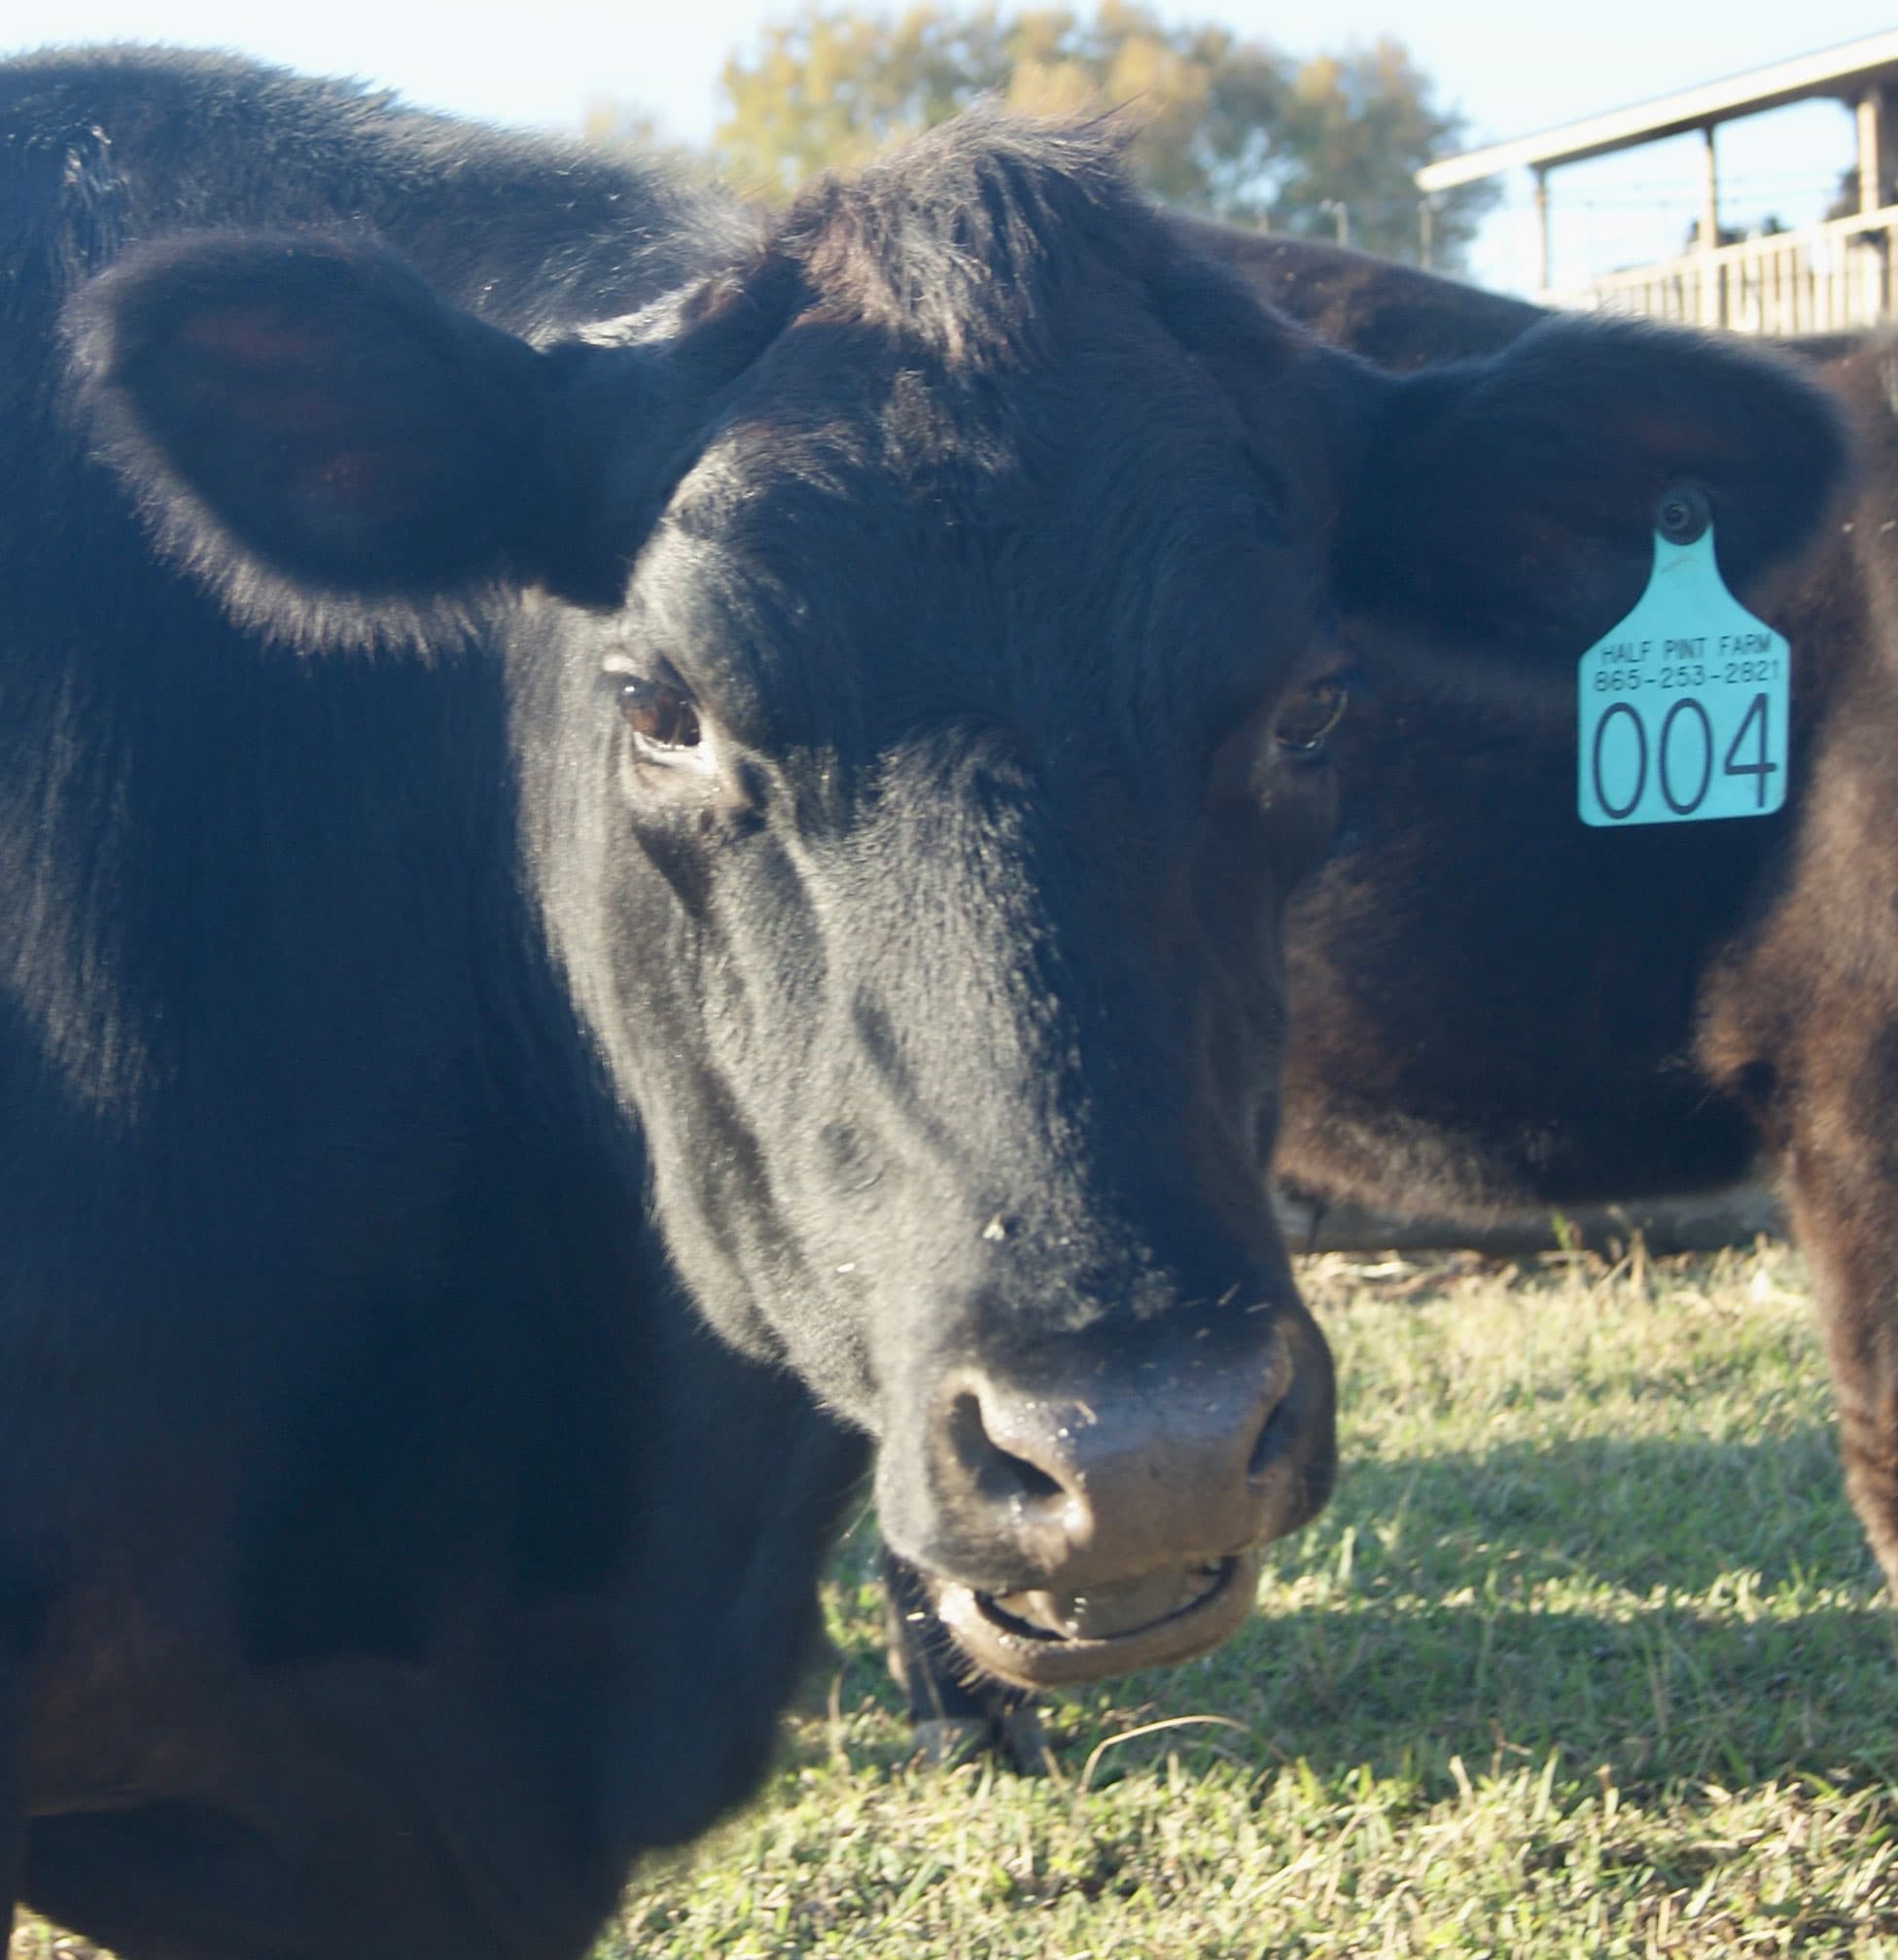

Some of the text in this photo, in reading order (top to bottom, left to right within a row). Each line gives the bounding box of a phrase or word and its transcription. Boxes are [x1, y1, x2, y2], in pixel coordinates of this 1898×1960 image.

[1602, 634, 1772, 663] HALF PINT FARM
[1593, 692, 1777, 820] 004
